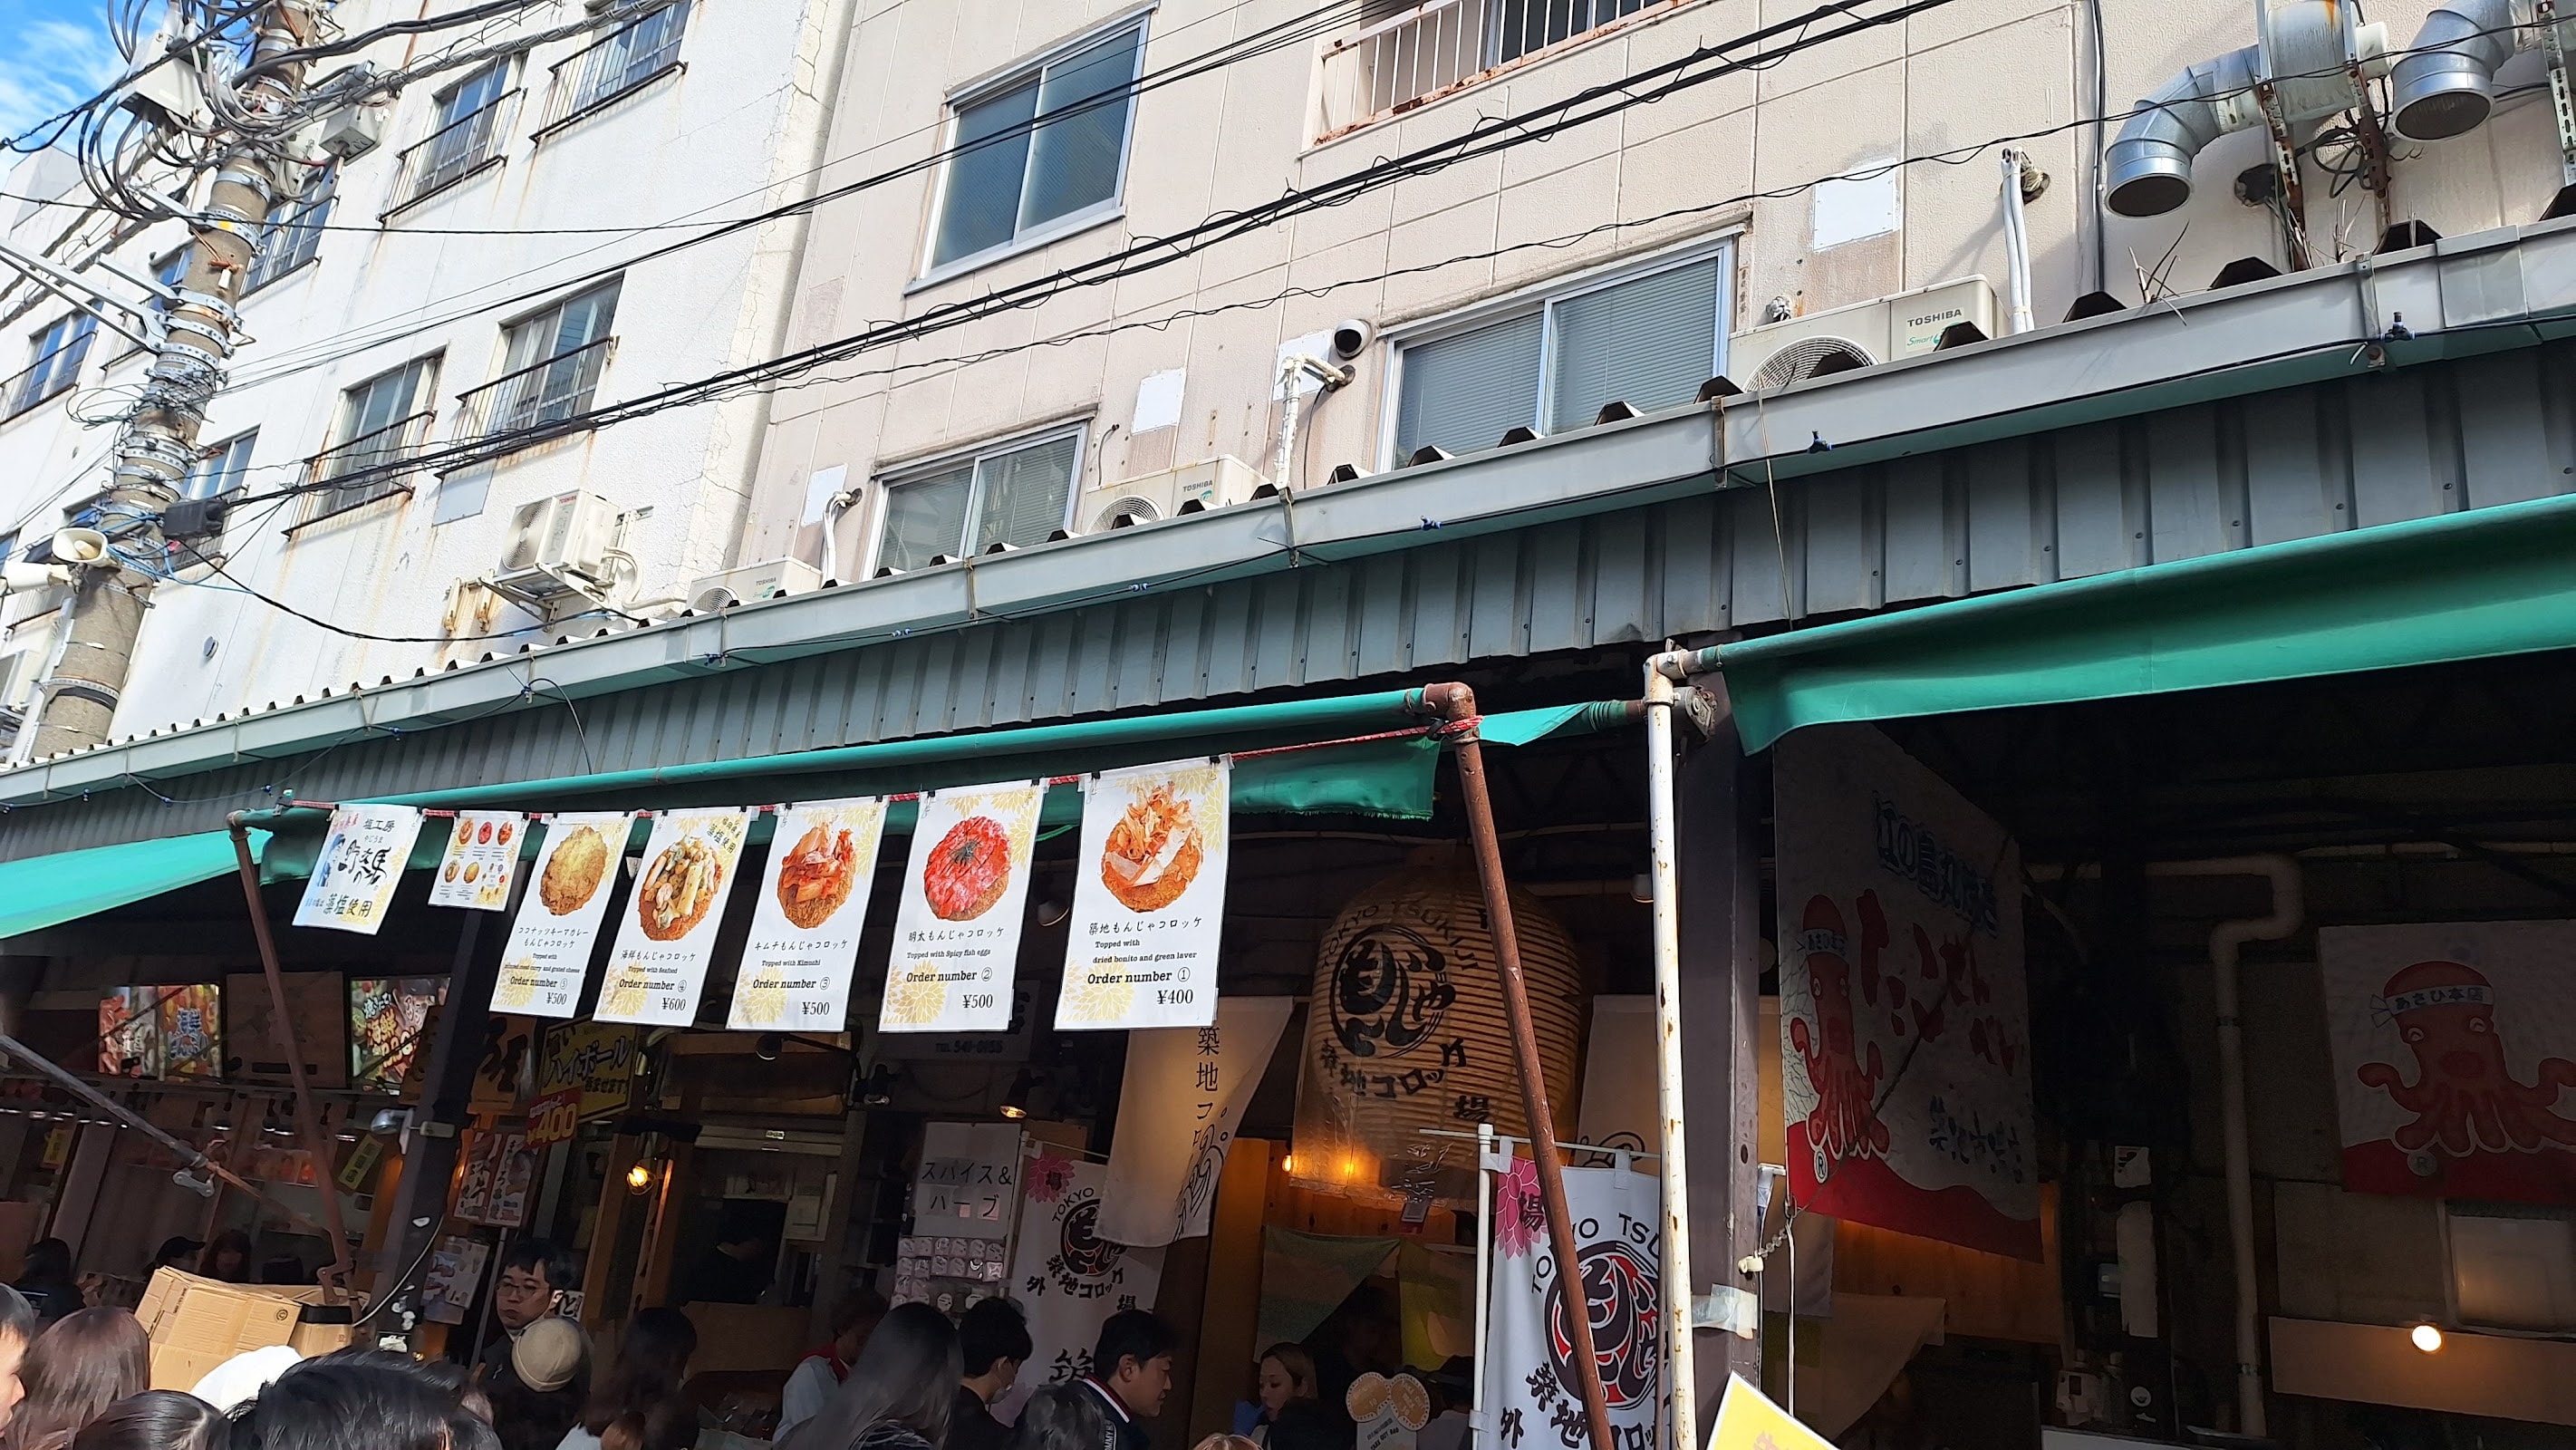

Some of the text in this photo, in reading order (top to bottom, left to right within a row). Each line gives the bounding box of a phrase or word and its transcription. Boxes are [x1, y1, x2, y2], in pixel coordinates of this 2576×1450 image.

[1906, 308, 1963, 327] TOSHIBA
[1182, 480, 1213, 492] TOSHIBA
[518, 926, 589, 937] ココナッツキーマカレー
[1088, 916, 1202, 935] 築地もんじゃコロッケ
[908, 926, 1004, 942] 明太もんじゃコロッケ
[1322, 905, 1379, 969] TOKYO
[524, 938, 575, 948] もんじゃコロッケ
[755, 939, 847, 952] キムチもんじゃコロッケ
[1095, 939, 1140, 949] Topped with
[621, 950, 697, 962] 海鮮もんじゃコロッケ
[946, 950, 963, 959] Spicy
[977, 948, 991, 957] eggs
[1114, 954, 1138, 963] bonito
[1154, 953, 1175, 962] green
[510, 976, 527, 986] Order
[529, 978, 558, 988] number
[906, 972, 935, 982] Order
[937, 971, 977, 981] number
[1087, 973, 1123, 984] Order
[1124, 972, 1172, 983] number
[619, 979, 642, 990] Order
[643, 981, 674, 991] number
[753, 979, 779, 989] Order
[780, 979, 816, 989] number
[545, 992, 567, 1005] ¥500
[962, 994, 993, 1009] ¥500
[1156, 989, 1193, 1004] ¥400
[2396, 987, 2484, 1010] あさひ本店
[661, 998, 686, 1011] ¥600
[802, 1001, 830, 1015] ¥500
[544, 1036, 632, 1087] ハイボール
[1320, 1037, 1467, 1097] 築地コロッケ
[931, 1194, 999, 1217] ハーブ
[1052, 1187, 1095, 1223] TOKYO
[1531, 1217, 1599, 1295] TOO
[1500, 1406, 1524, 1450] 外
